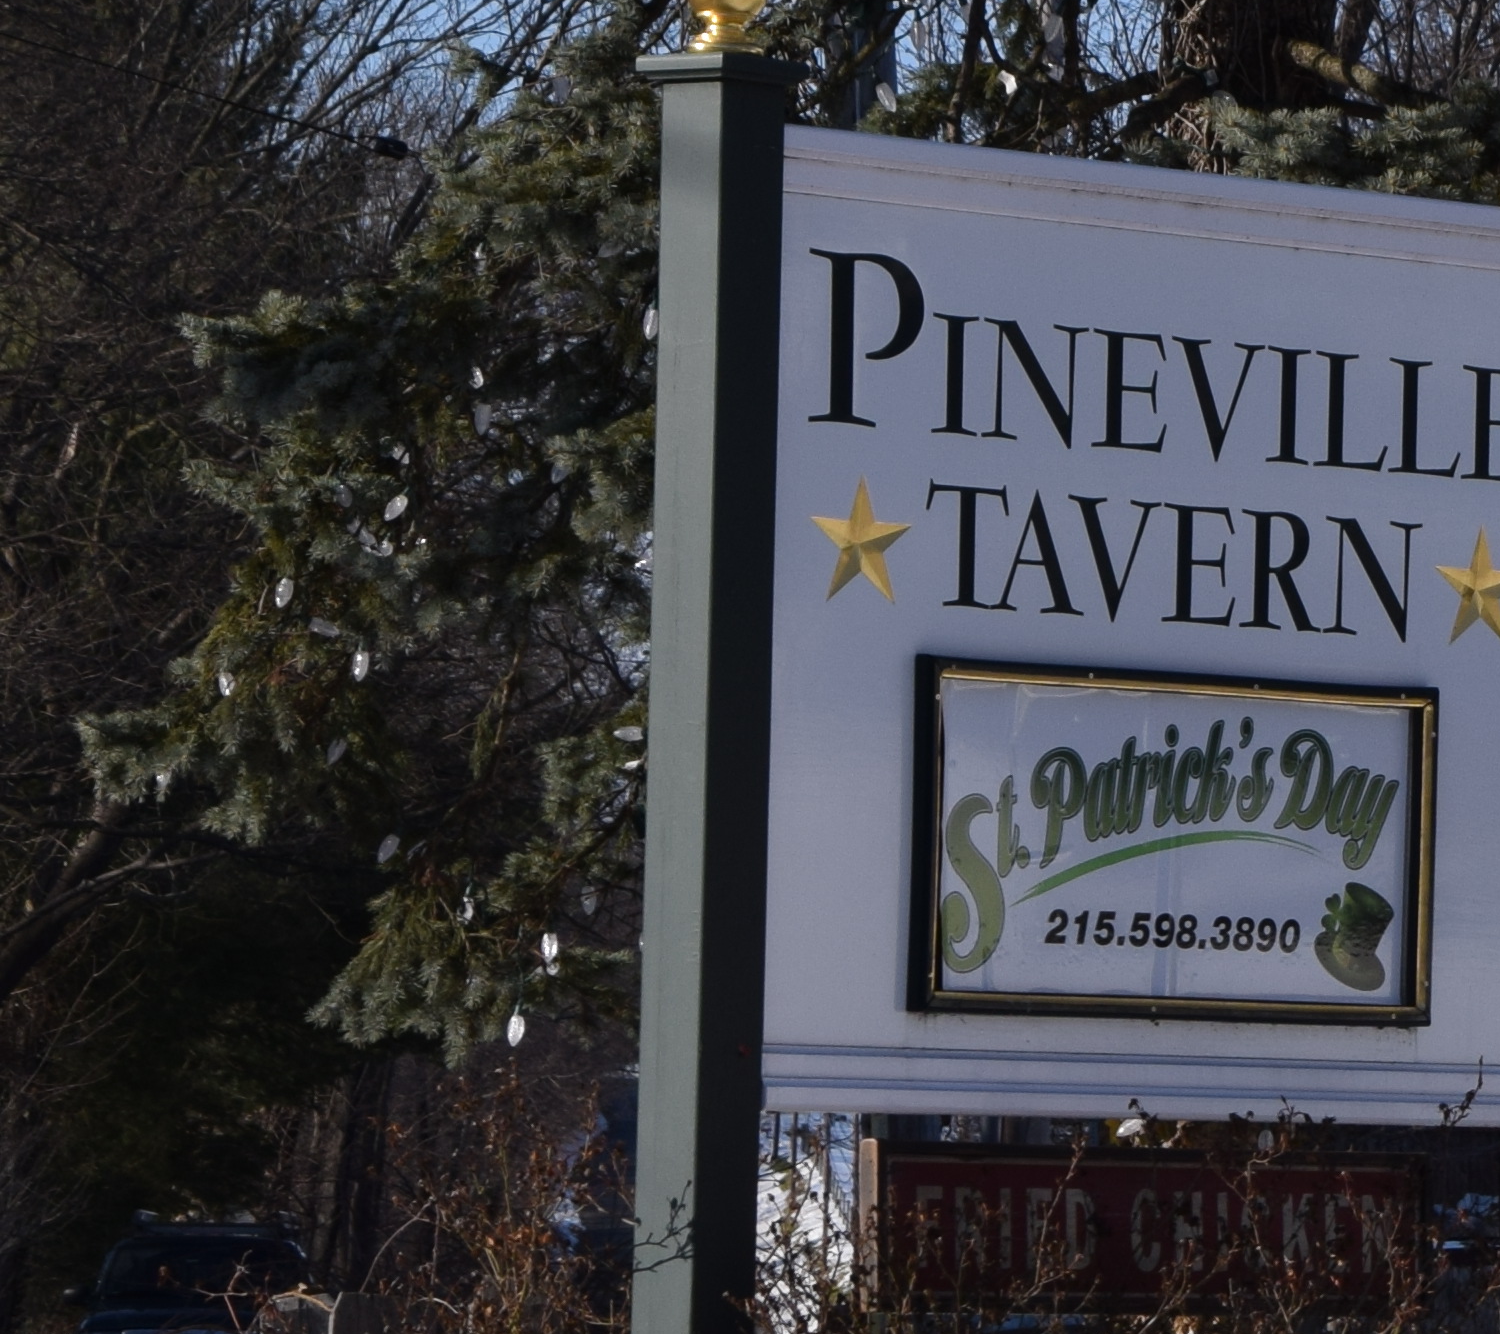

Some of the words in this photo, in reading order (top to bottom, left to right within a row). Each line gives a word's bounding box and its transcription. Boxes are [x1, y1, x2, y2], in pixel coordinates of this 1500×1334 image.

[925, 478, 1427, 645] TAVERN
[942, 774, 1030, 974] St.
[1030, 716, 1275, 870] Patrick's
[1274, 728, 1400, 871] Day
[1045, 908, 1301, 954] 215.598.3890
[915, 1185, 1097, 1272] FRIED
[1130, 1188, 1393, 1274] CHICKEN
